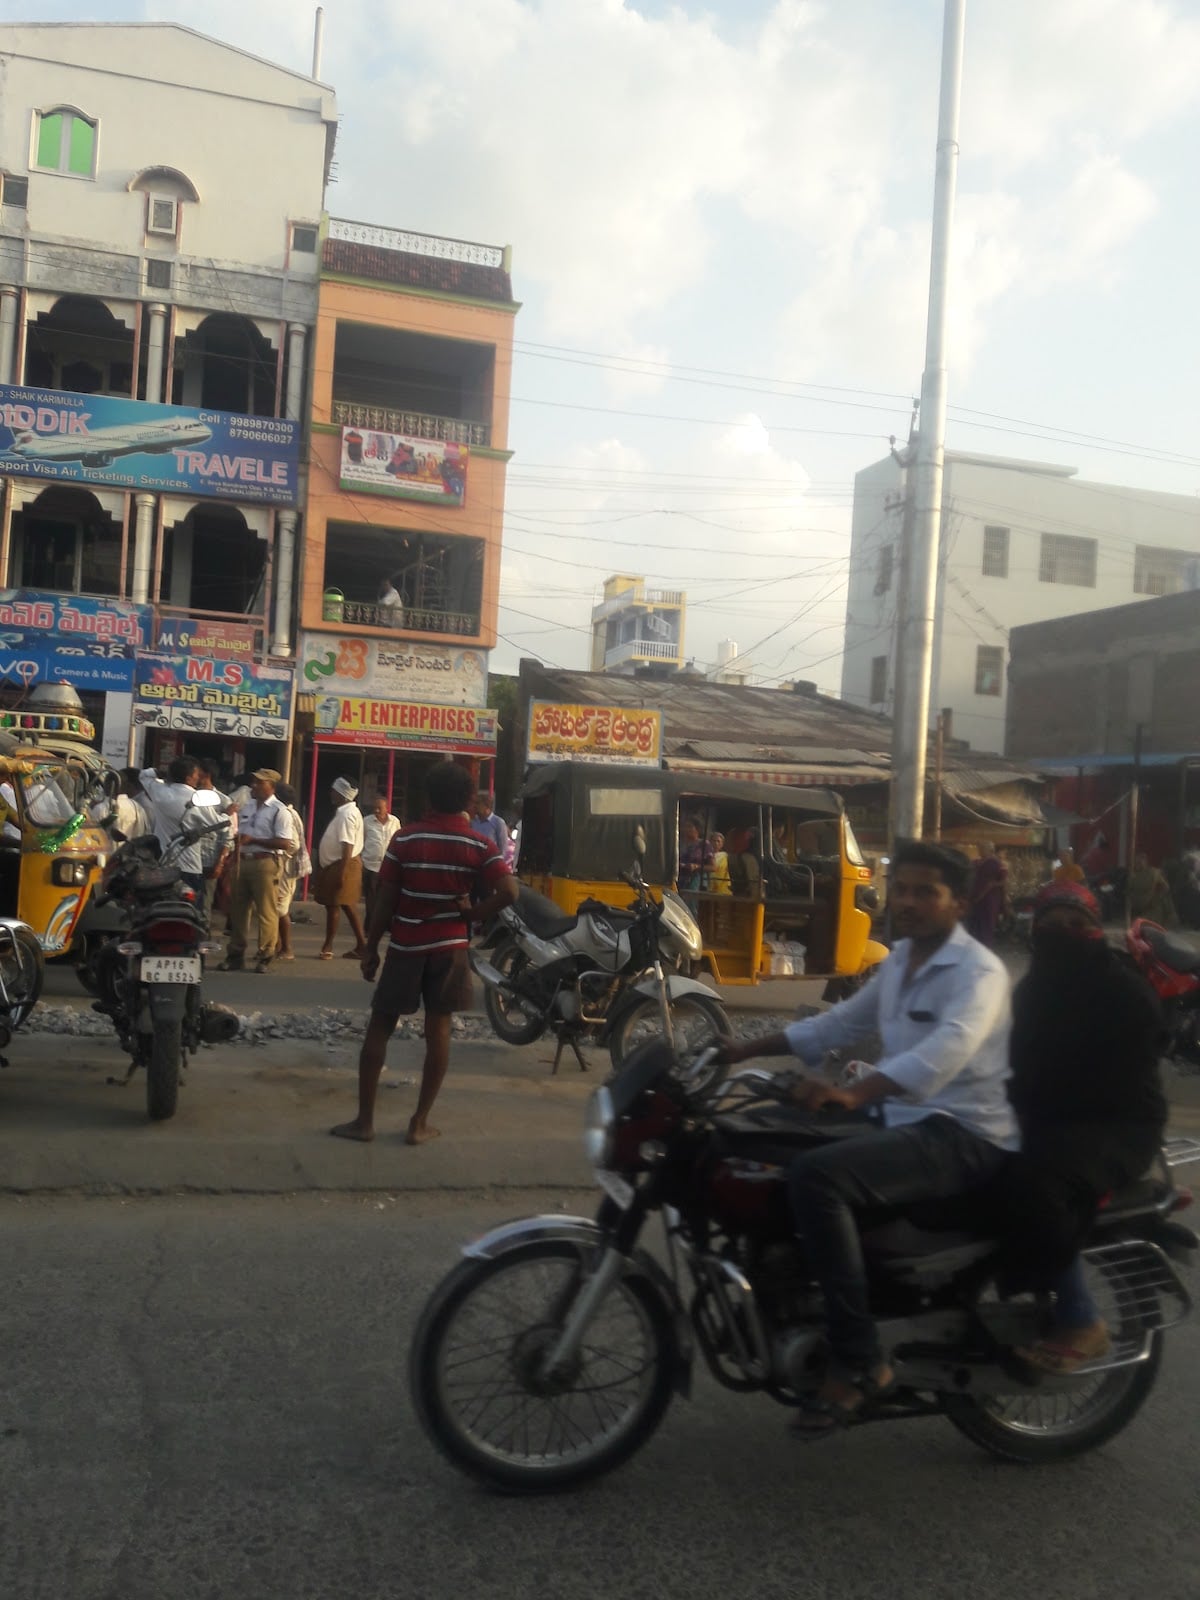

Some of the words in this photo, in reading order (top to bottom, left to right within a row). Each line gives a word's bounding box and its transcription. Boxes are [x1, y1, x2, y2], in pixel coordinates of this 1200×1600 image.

[10, 390, 36, 401] SHAIK
[37, 393, 85, 407] KARIMULLA
[0, 402, 93, 438] IDDIK
[199, 412, 220, 424] Cell
[230, 416, 294, 433] 9989870300
[229, 428, 293, 444] 8790606027
[33, 463, 58, 475] Visa
[61, 466, 78, 477] Air
[54, 666, 90, 678] Camera
[91, 670, 100, 679] &
[101, 671, 129, 681] Music
[186, 658, 244, 687] M.S
[138, 682, 200, 703] ఆటో
[340, 700, 367, 725] A-1
[369, 701, 476, 734] ENTERPRISES
